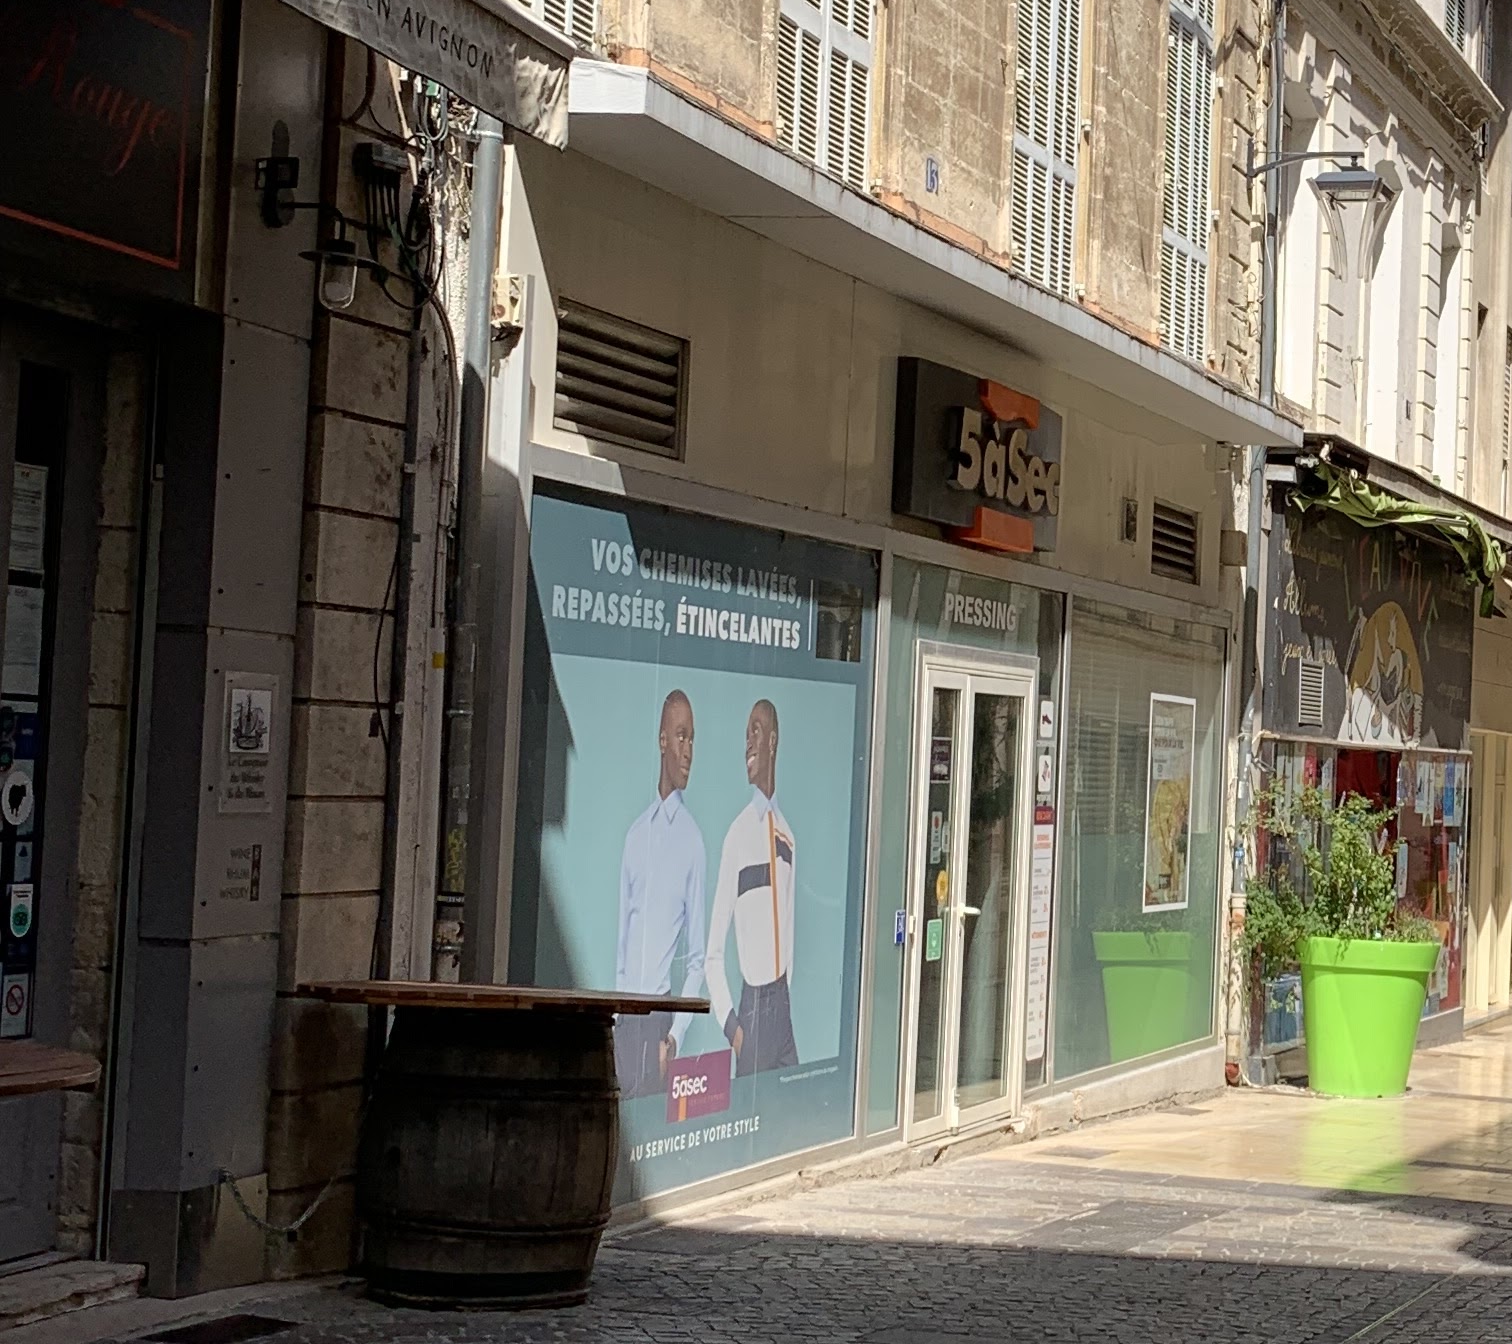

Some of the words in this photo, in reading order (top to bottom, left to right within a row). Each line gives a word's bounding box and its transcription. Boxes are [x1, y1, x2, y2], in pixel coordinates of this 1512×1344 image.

[401, 6, 494, 78] AVIGNON
[590, 537, 634, 576] VOS
[638, 548, 732, 594] CHEMISES
[736, 566, 801, 609] LAVÉES,
[552, 584, 671, 637] REPASSÉES,
[676, 595, 801, 650] ÉTINCELANTES
[944, 592, 1017, 632] PRESSING
[629, 1145, 643, 1162] AU
[645, 1133, 685, 1158] SERVICE
[688, 1130, 701, 1148] DE
[703, 1122, 731, 1144] VOTRE
[734, 1115, 760, 1136] STYLE
